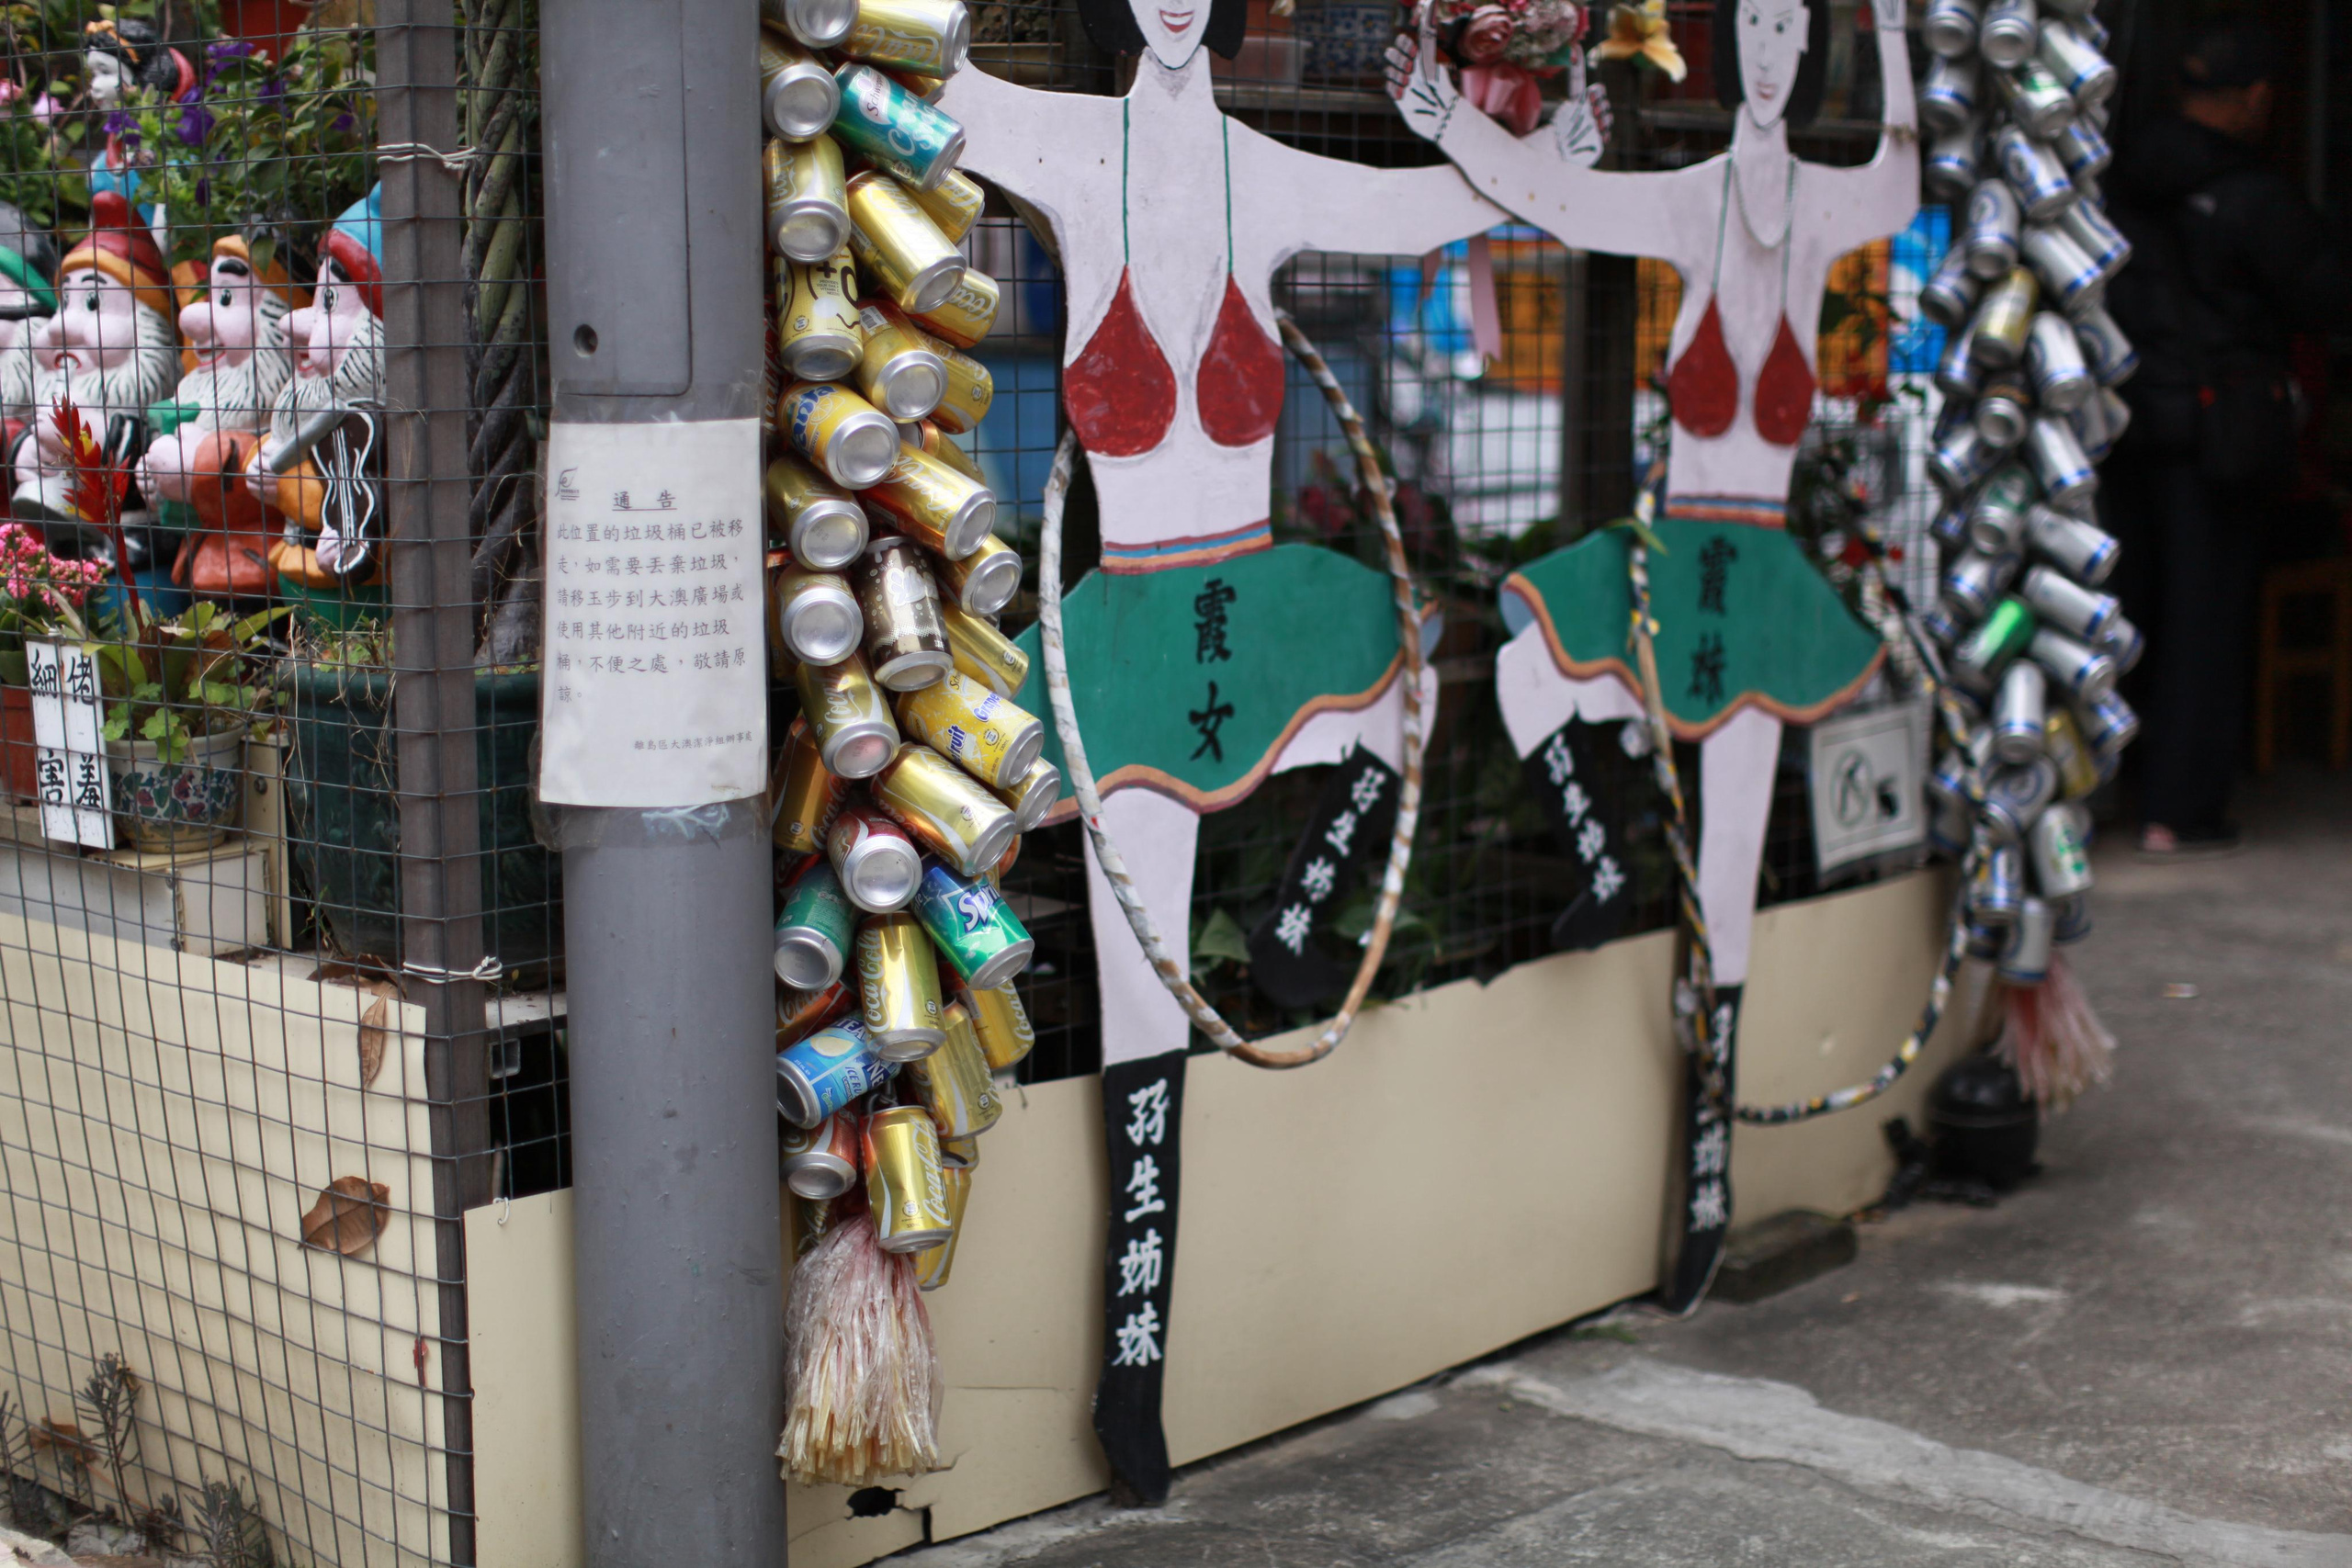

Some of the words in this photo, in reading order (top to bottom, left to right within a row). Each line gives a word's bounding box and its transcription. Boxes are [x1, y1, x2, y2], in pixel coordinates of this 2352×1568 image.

[613, 489, 676, 509] 通告
[557, 518, 743, 543] 此位置的垃圾桶已被移
[557, 582, 744, 608] 請移玉步到大澳廣場或
[557, 618, 730, 640] 使用其他附近的垃圾
